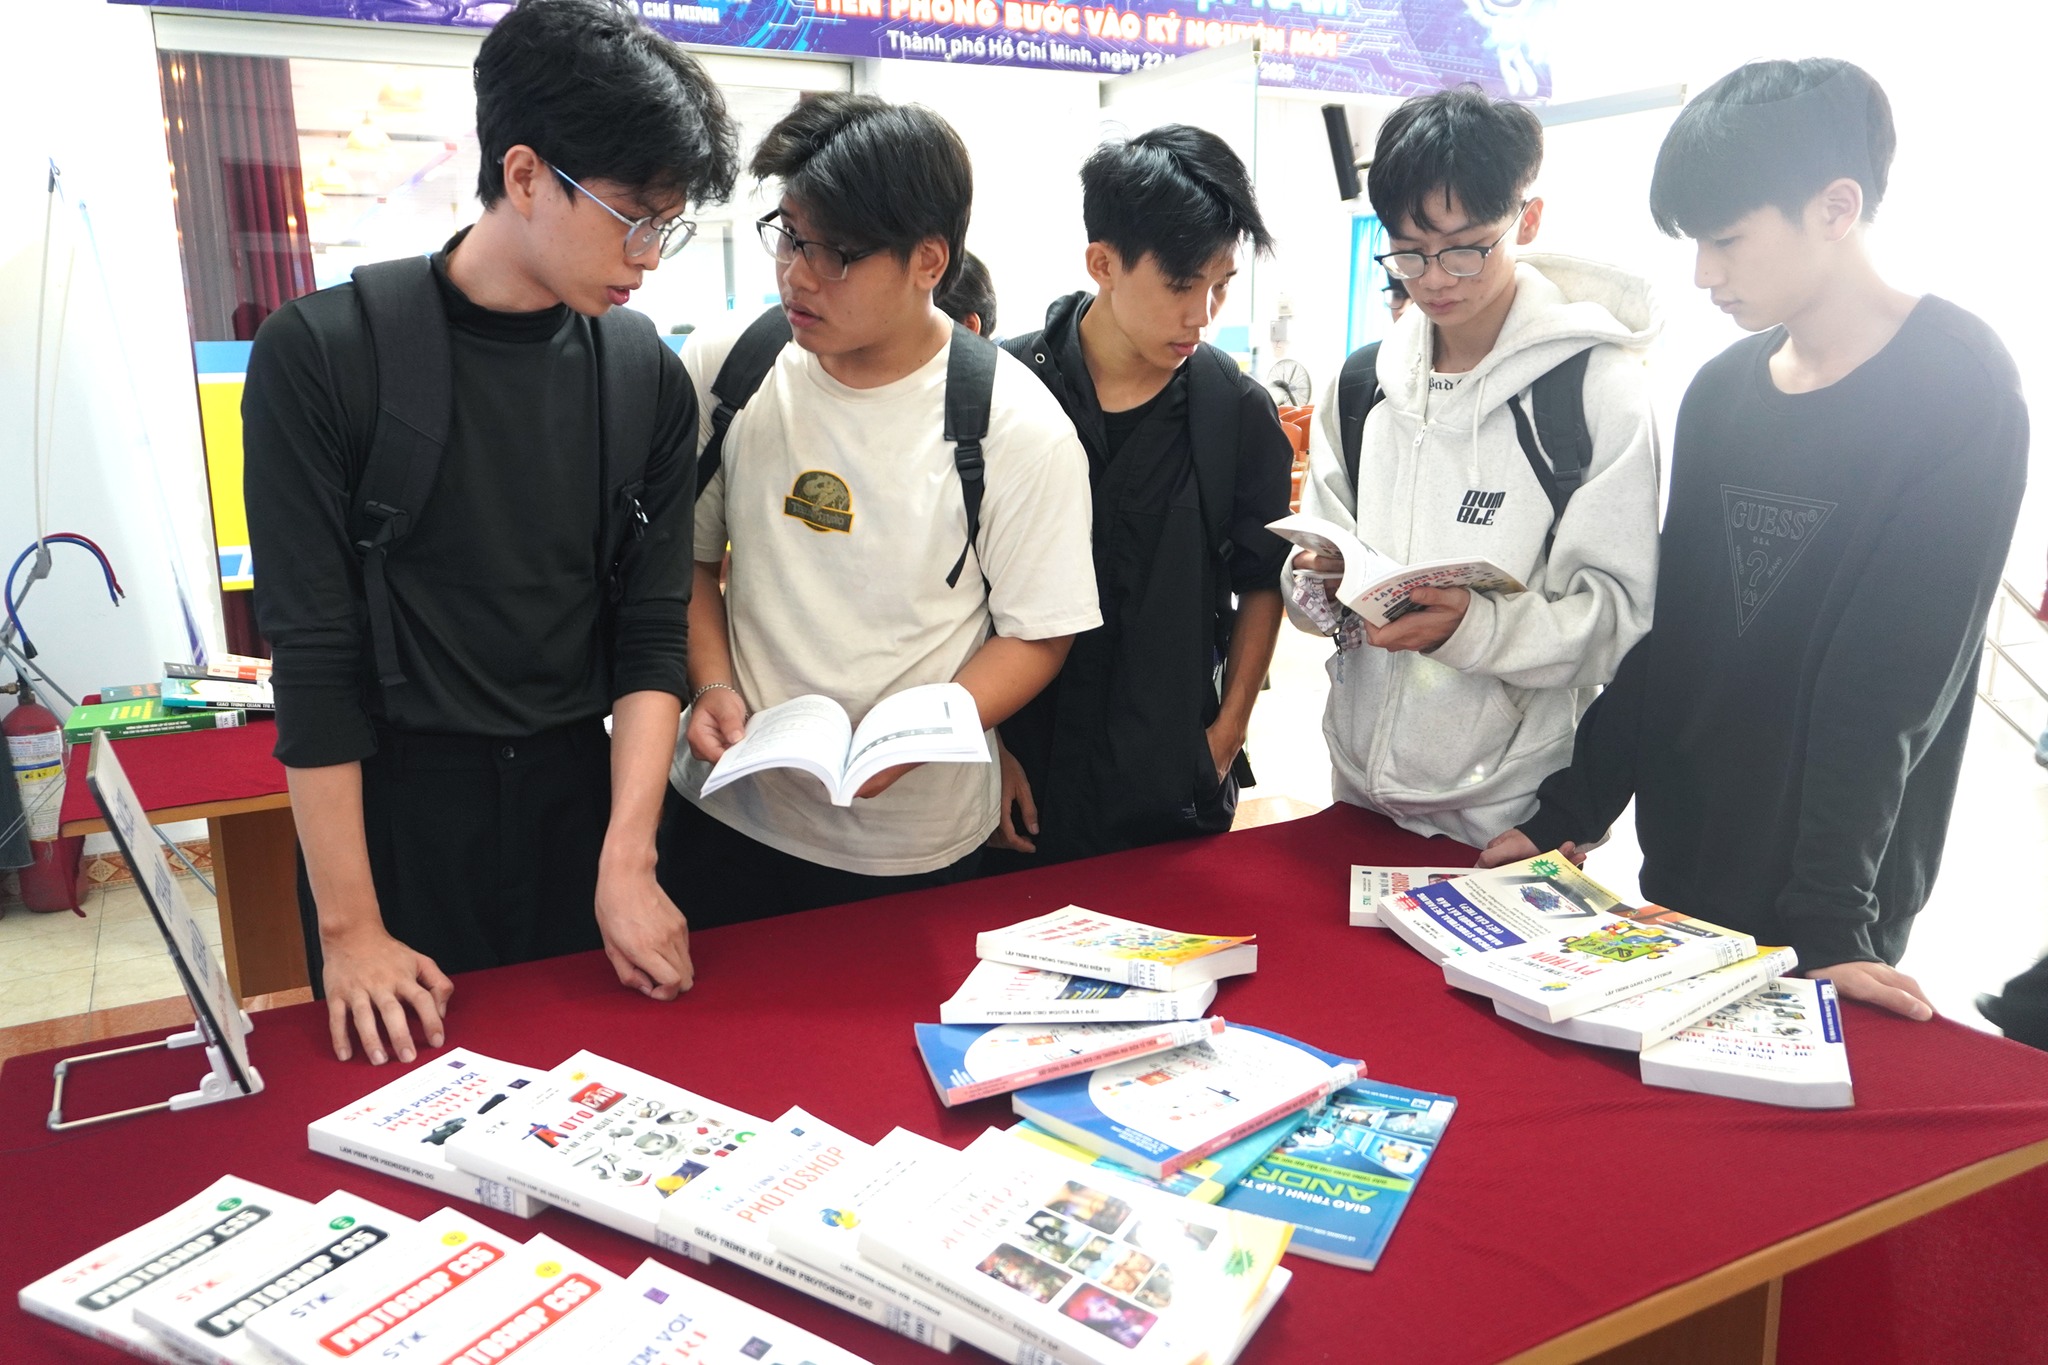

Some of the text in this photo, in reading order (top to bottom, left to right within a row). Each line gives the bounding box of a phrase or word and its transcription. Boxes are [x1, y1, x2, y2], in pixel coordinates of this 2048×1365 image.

[674, 4, 721, 24] MINH
[1084, 3, 1141, 39] VÀO
[886, 29, 947, 54] Thành
[950, 35, 987, 58] phố
[988, 37, 1015, 57] Hồ
[1017, 40, 1047, 61] Chí
[1050, 41, 1099, 68] Minh,
[1101, 50, 1141, 73] ngày
[1526, 950, 1602, 976] PYTHON
[736, 1145, 846, 1223] PHOTOSHOP
[1248, 1163, 1379, 1203] ANDR
[1254, 1180, 1370, 1215] GIÁO TRÌNH LẬP
[88, 1210, 262, 1306] PHOTOSHOP CS5
[693, 1226, 716, 1243] GIÁO
[798, 1271, 855, 1302] PHOTOSHOP
[207, 1229, 379, 1333] PHOTOSHOP CS5
[328, 1245, 496, 1351] PHOTOSHOP CS5
[542, 1277, 592, 1313] CS5
[290, 1292, 338, 1319] STK
[382, 1330, 429, 1360] STK
